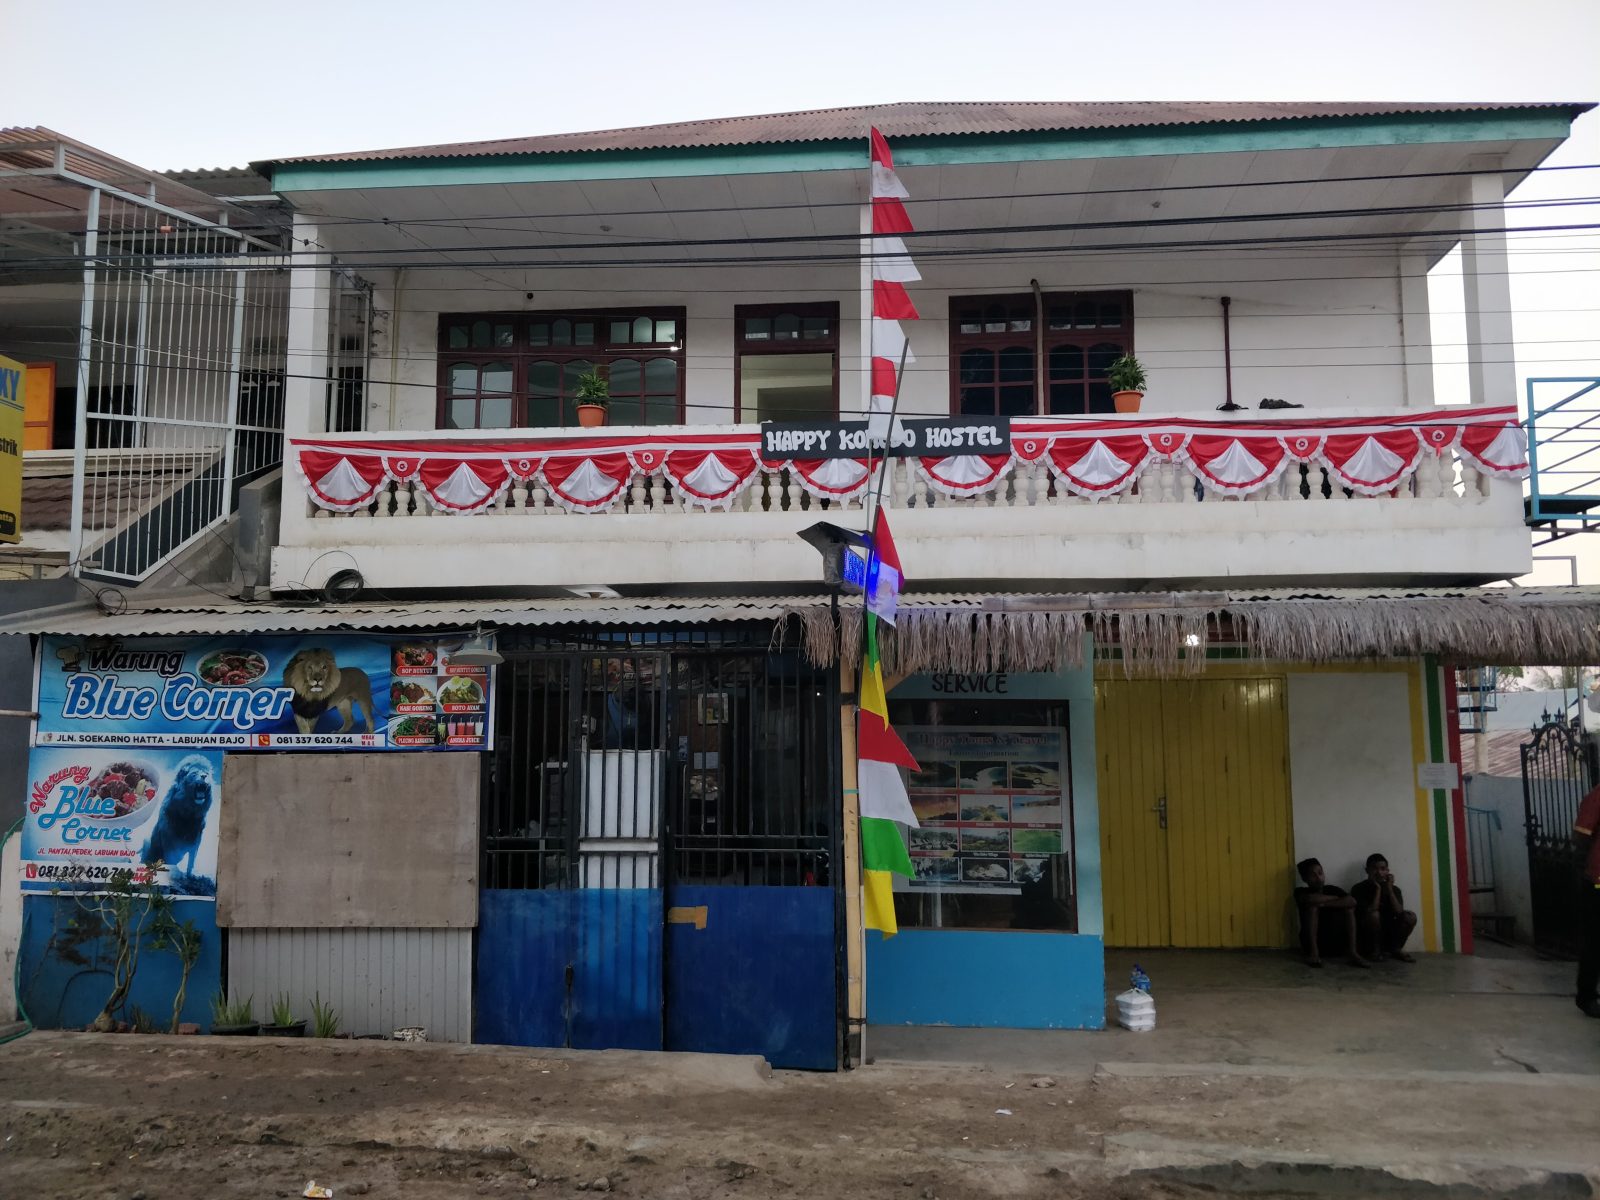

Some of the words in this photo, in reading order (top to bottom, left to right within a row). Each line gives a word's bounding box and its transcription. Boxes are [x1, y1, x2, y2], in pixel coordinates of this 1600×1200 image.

[766, 430, 831, 452] HAPPY
[925, 425, 1003, 449] HOSTEL
[87, 644, 185, 676] Warung
[931, 673, 1009, 694] SERVICE
[62, 672, 158, 719] Blue
[160, 672, 296, 729] Corner
[79, 734, 131, 743] SOEKARNO
[133, 735, 164, 743] HATTA
[172, 736, 217, 744] LABUHAN
[219, 736, 245, 744] BAJO
[276, 736, 293, 744] 081
[295, 736, 312, 744] 337
[314, 736, 333, 744] 620
[335, 736, 353, 744] 744
[30, 766, 91, 813] Warung
[38, 785, 116, 829] Blue
[61, 818, 132, 843] Corner
[85, 867, 109, 879] 620
